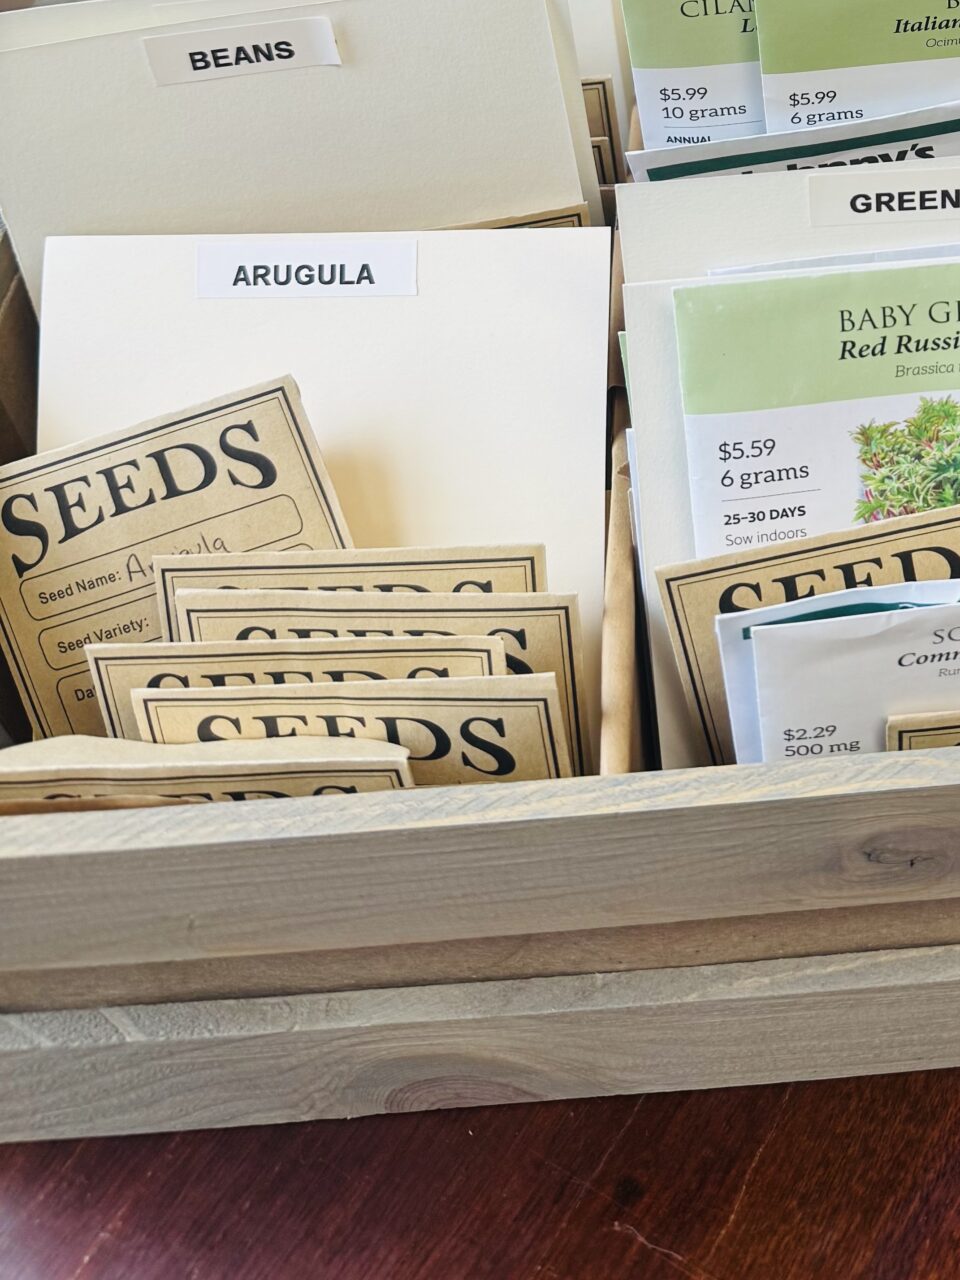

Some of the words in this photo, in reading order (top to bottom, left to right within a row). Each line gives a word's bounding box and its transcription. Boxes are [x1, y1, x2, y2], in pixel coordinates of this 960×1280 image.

[188, 40, 295, 71] BEANS
[659, 86, 708, 103] $5.99
[789, 90, 837, 108] $5.99
[662, 106, 684, 120] 10
[689, 104, 747, 122] grams
[790, 111, 801, 125] 6
[806, 107, 864, 126] grams
[232, 263, 376, 287] ARUGULA
[838, 303, 917, 333] BABY
[837, 335, 888, 360] Red
[894, 361, 955, 378] Brassica
[718, 438, 776, 462] $5.59
[720, 470, 734, 488] 6
[740, 463, 810, 492] grams
[0, 420, 278, 578] SEEDS
[769, 505, 807, 520] DAYS
[725, 531, 753, 547] Sow
[756, 525, 808, 544] indoors
[38, 586, 73, 605] Seed
[75, 571, 122, 593] Name:
[57, 634, 92, 655] Seed
[93, 617, 149, 644] Variety:
[784, 724, 837, 743] $2.29
[784, 741, 824, 758] 500
[828, 738, 860, 756] mg
